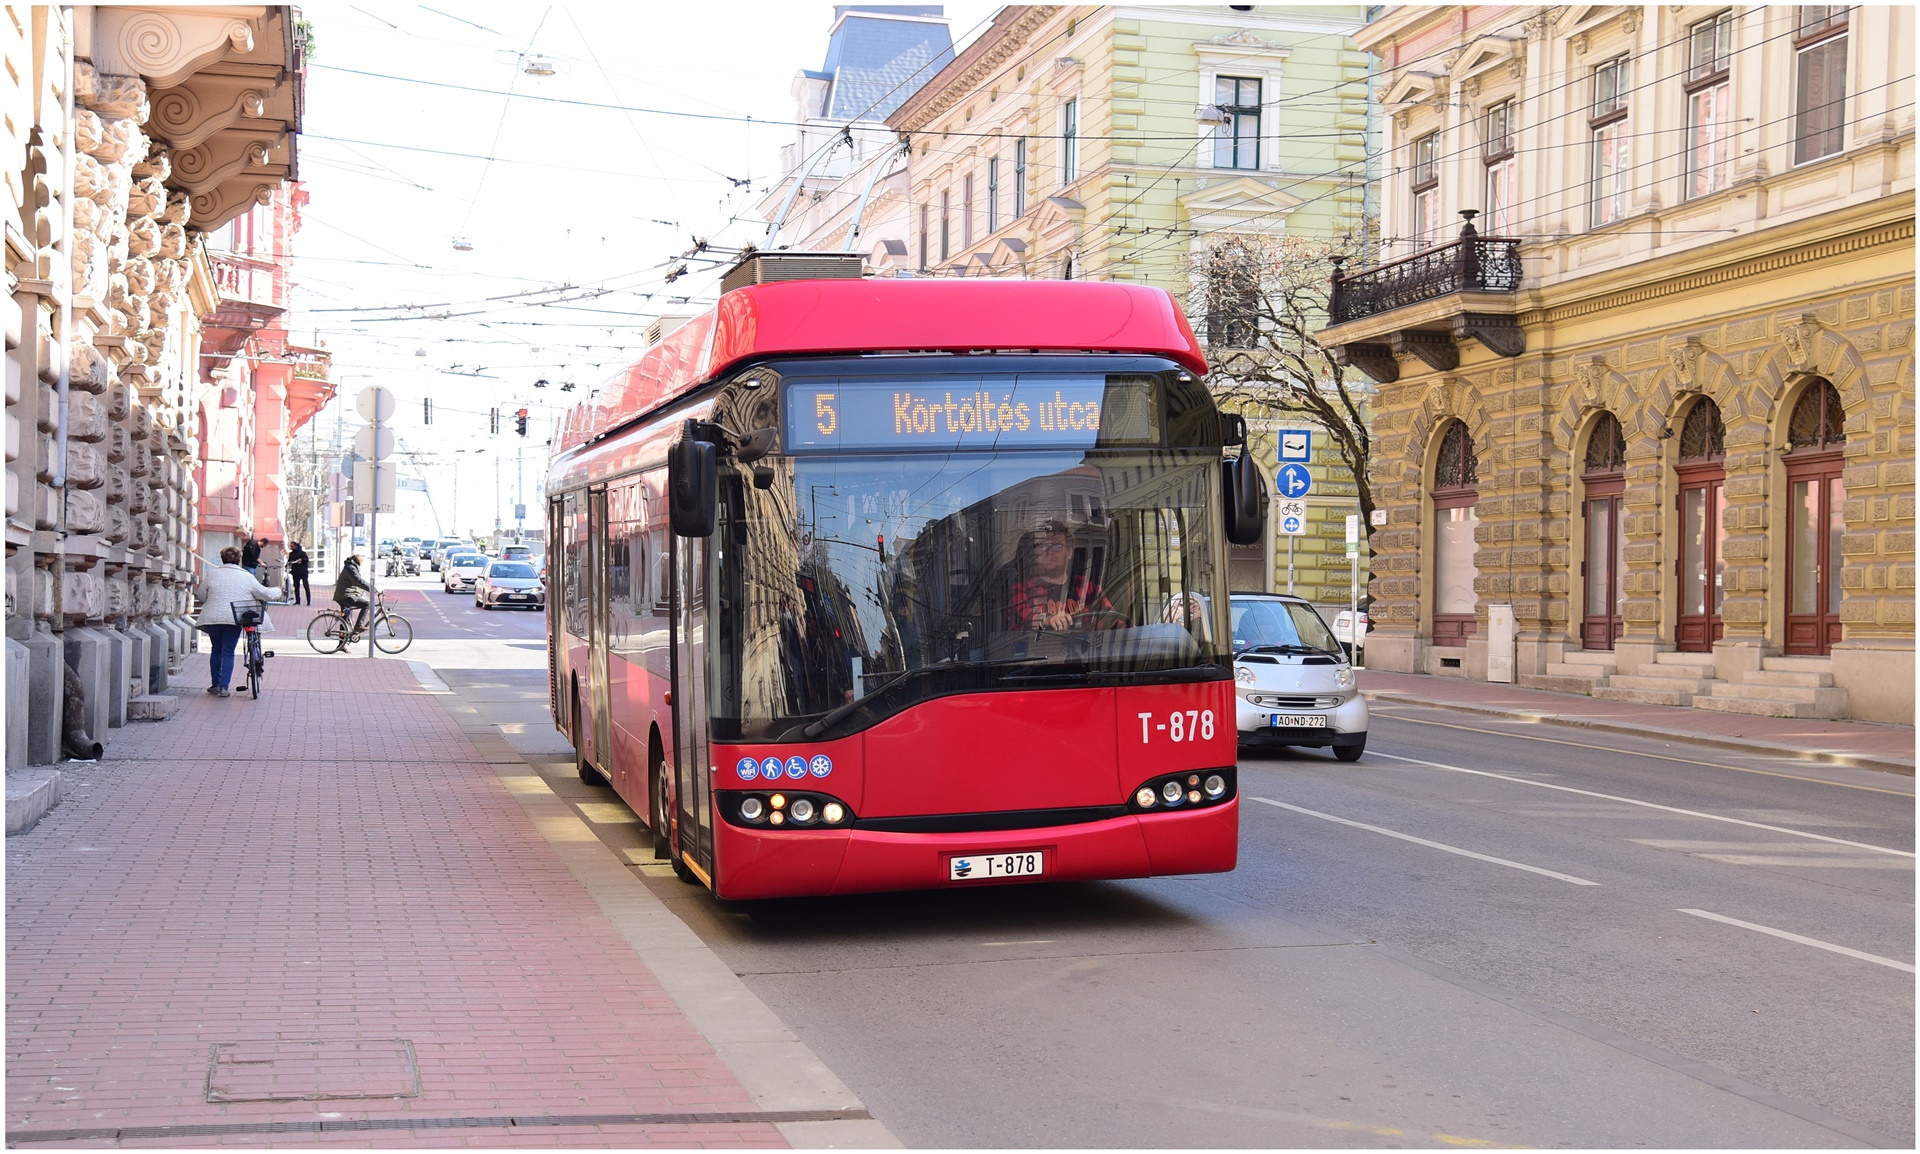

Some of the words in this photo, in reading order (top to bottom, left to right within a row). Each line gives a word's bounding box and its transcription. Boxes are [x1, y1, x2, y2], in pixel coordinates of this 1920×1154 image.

[815, 393, 836, 435] 5
[893, 391, 1031, 433] Körtöltés
[1038, 390, 1100, 431] utca
[1137, 709, 1215, 744] T-878
[985, 854, 1035, 876] T-878
